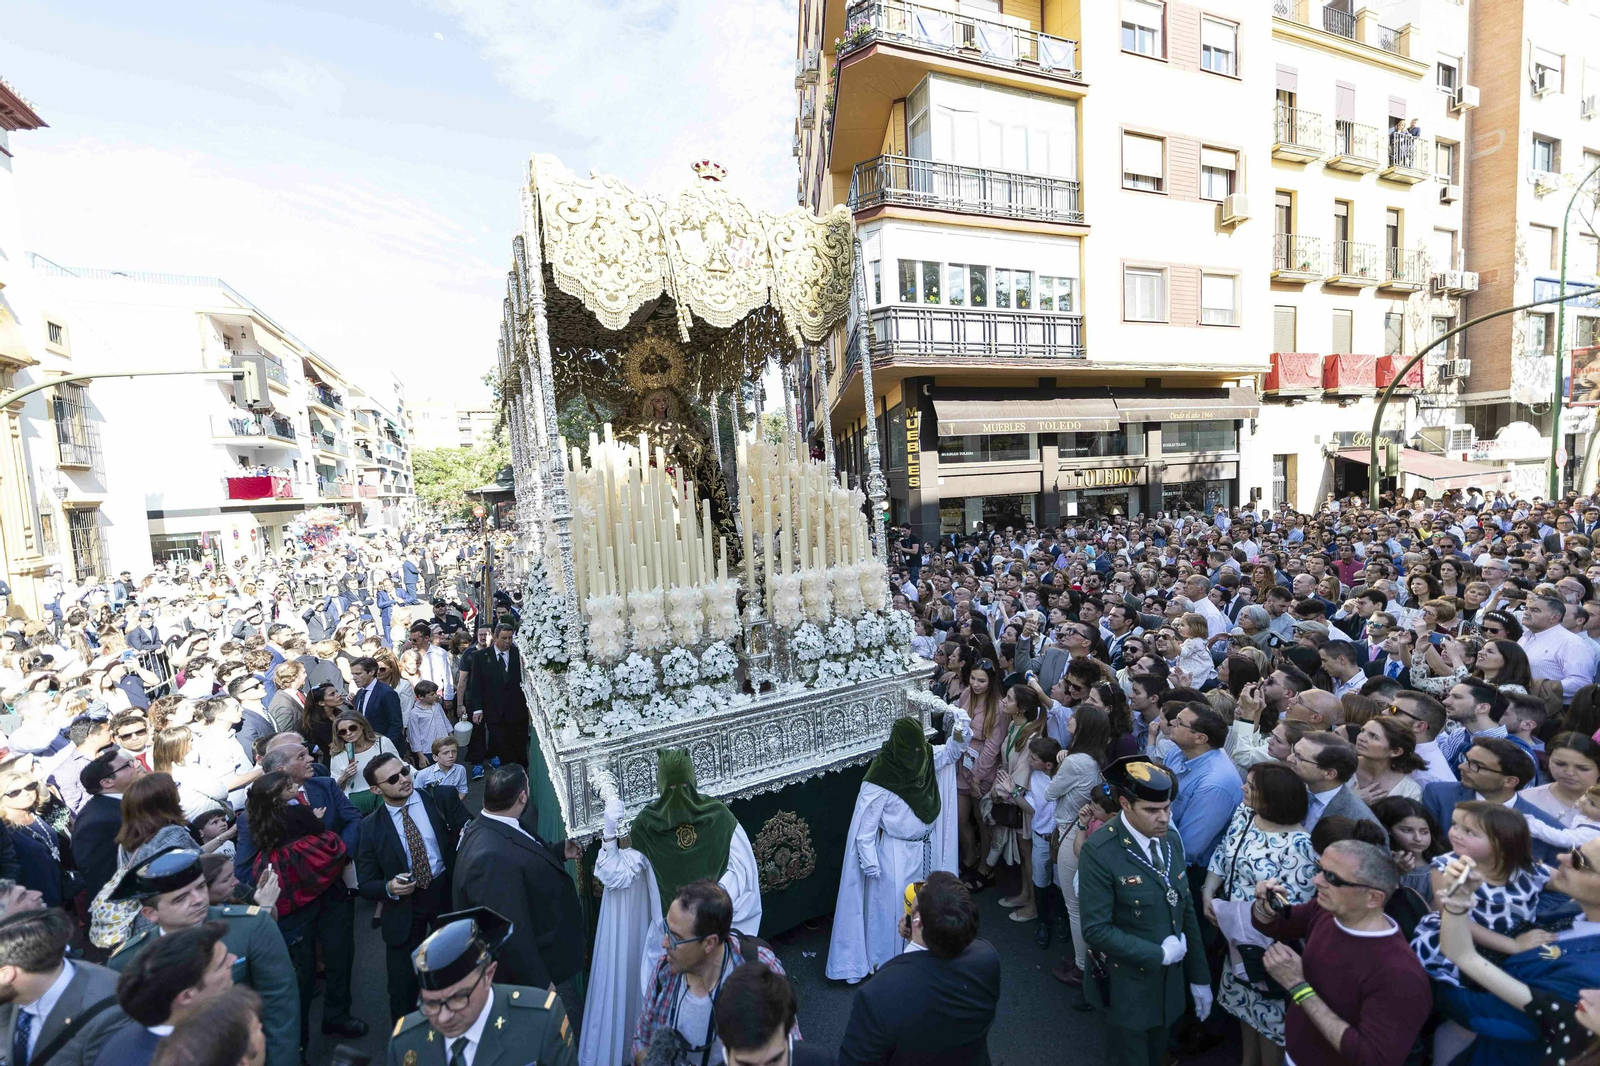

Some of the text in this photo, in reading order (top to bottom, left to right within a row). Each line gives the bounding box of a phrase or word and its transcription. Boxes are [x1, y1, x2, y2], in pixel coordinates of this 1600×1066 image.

[982, 420, 1082, 433] MUEBLES TOLEDO
[905, 406, 920, 487] MUEBLES
[1075, 467, 1133, 488] TOLEDO
